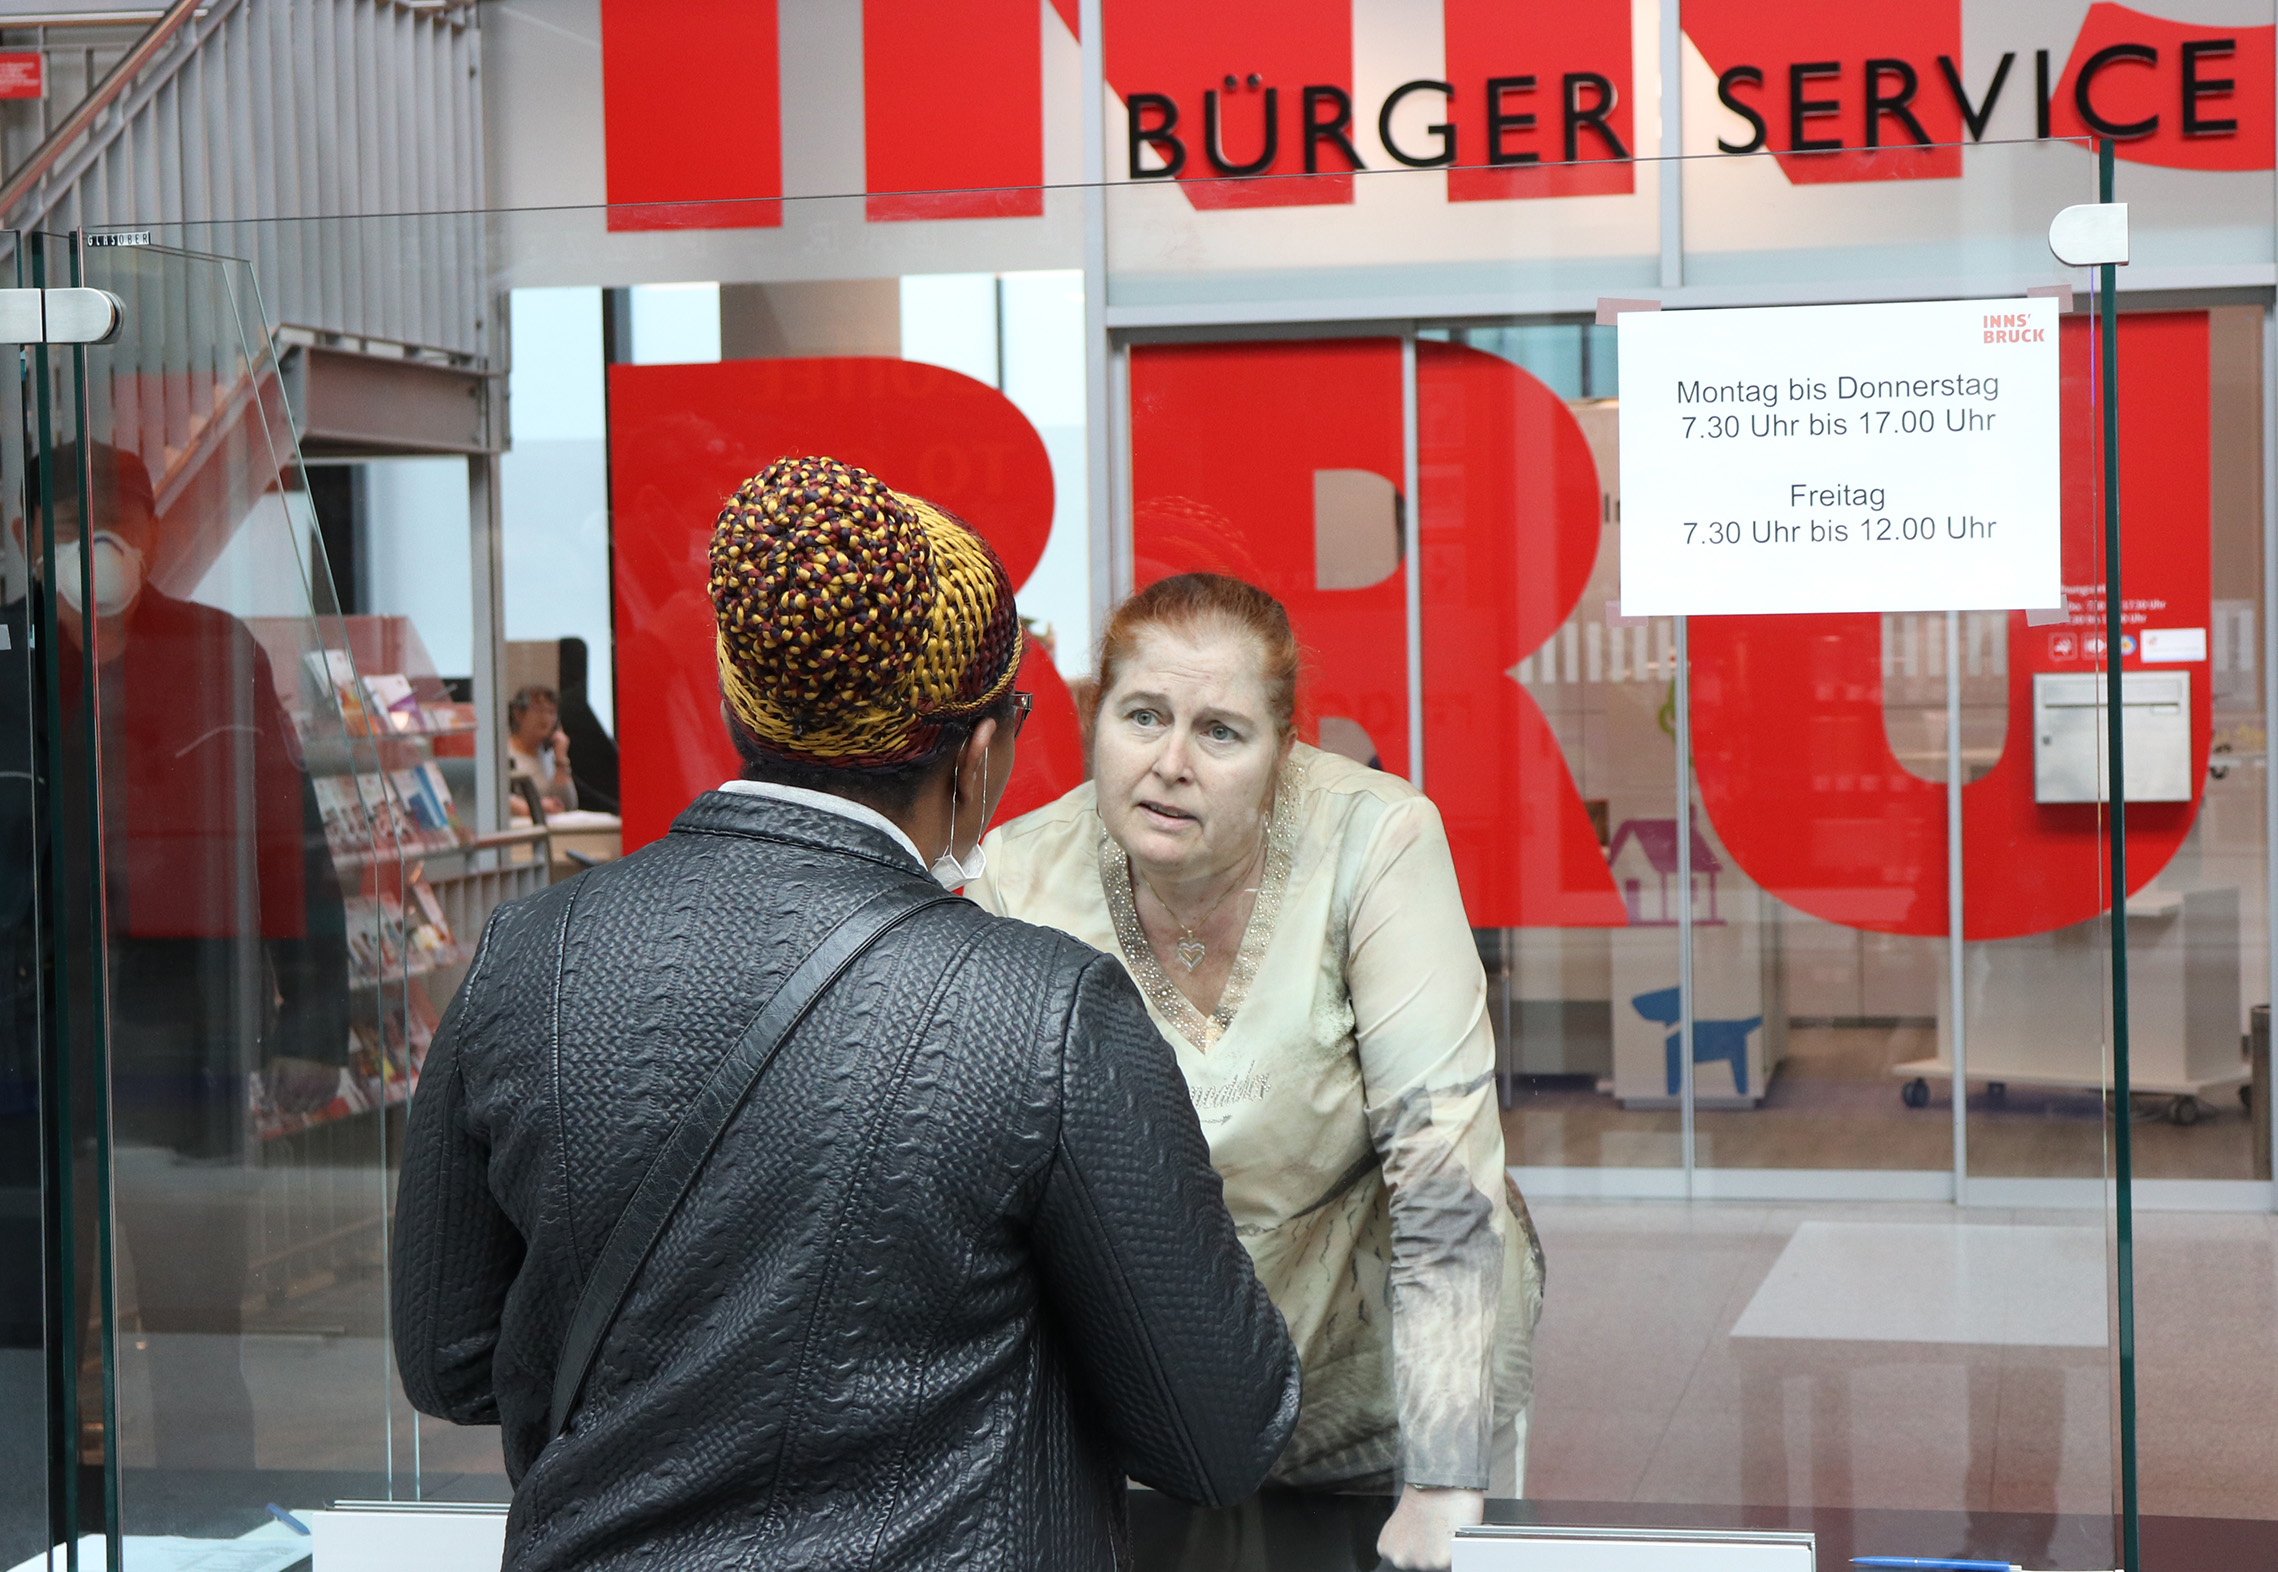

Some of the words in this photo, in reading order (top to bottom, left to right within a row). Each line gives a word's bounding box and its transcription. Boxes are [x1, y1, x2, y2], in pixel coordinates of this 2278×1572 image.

[1127, 72, 1634, 181] BÜRGER
[1717, 39, 2239, 156] SERVICE
[88, 233, 148, 246] GLASOBER
[1983, 328, 2045, 344] BRUCK
[1677, 380, 1778, 408] Montag
[1789, 377, 1828, 401] bis
[1838, 373, 1999, 401] Donnerstag
[1682, 415, 1740, 439] 7.30
[1751, 413, 1800, 438] Uhr
[1809, 412, 1848, 436] bis
[1859, 410, 1935, 434] 17.00
[1946, 408, 1997, 432] Uhr
[1790, 483, 1886, 512] Freitag
[1683, 521, 1741, 545] 7.30
[1752, 520, 1801, 544] Uhr
[1810, 518, 1849, 543] bis
[1860, 516, 1936, 541] 12.00
[1947, 515, 1998, 540] Uhr
